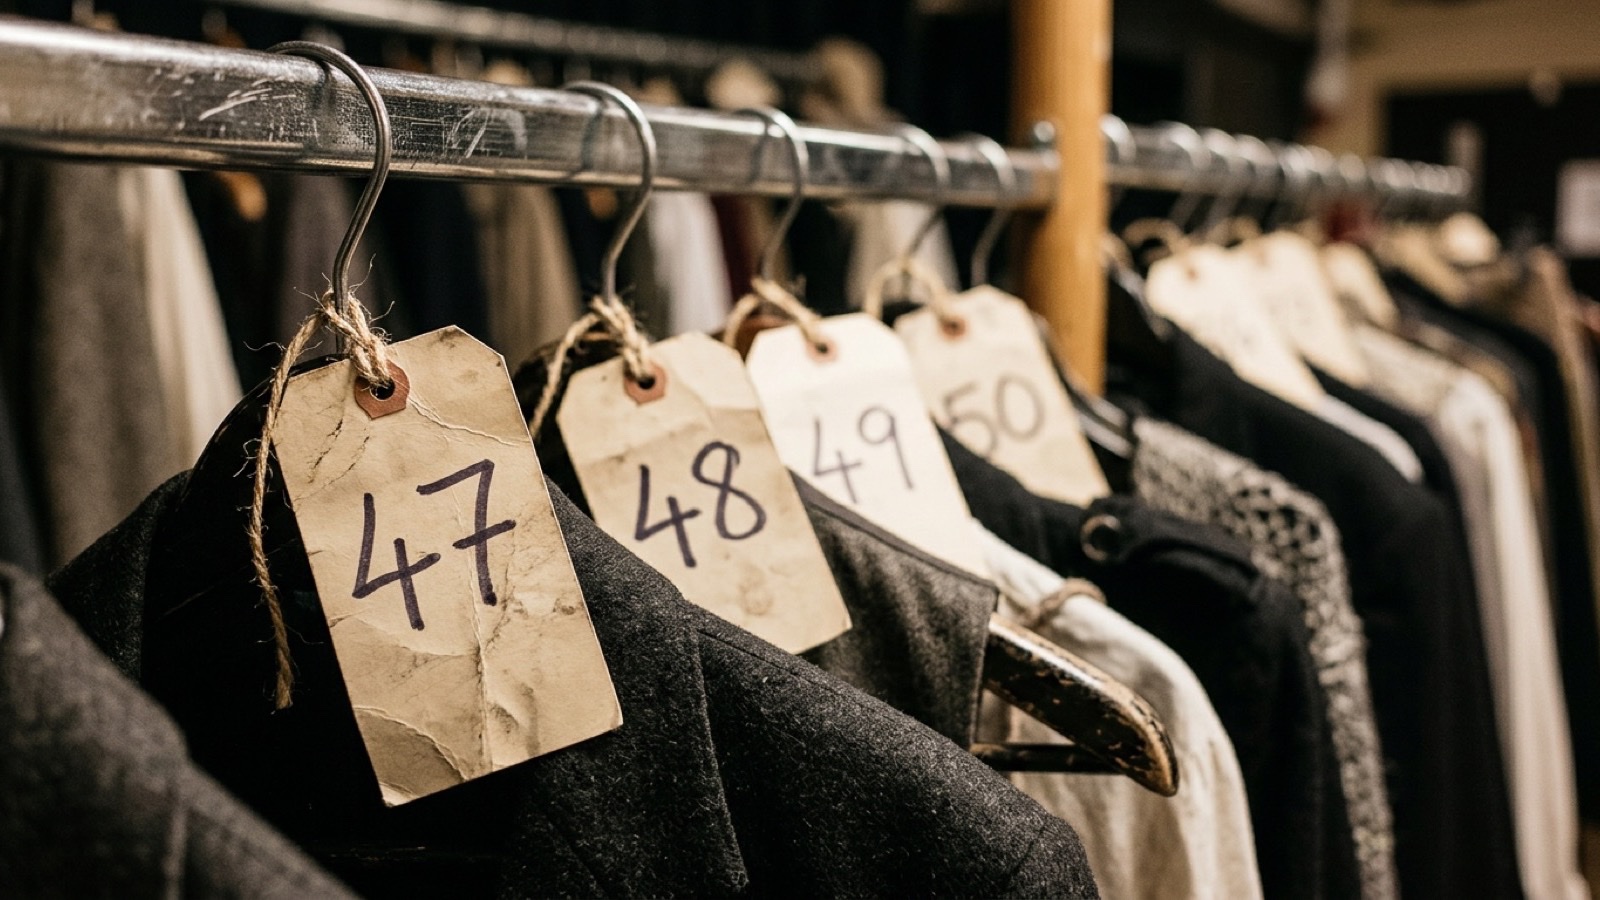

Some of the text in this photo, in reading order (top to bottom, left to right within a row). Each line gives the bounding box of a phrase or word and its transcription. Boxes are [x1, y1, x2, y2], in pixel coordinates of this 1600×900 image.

[812, 406, 914, 504] 49
[941, 373, 1046, 458] 50
[352, 459, 516, 631] 47
[634, 441, 767, 569] 48
